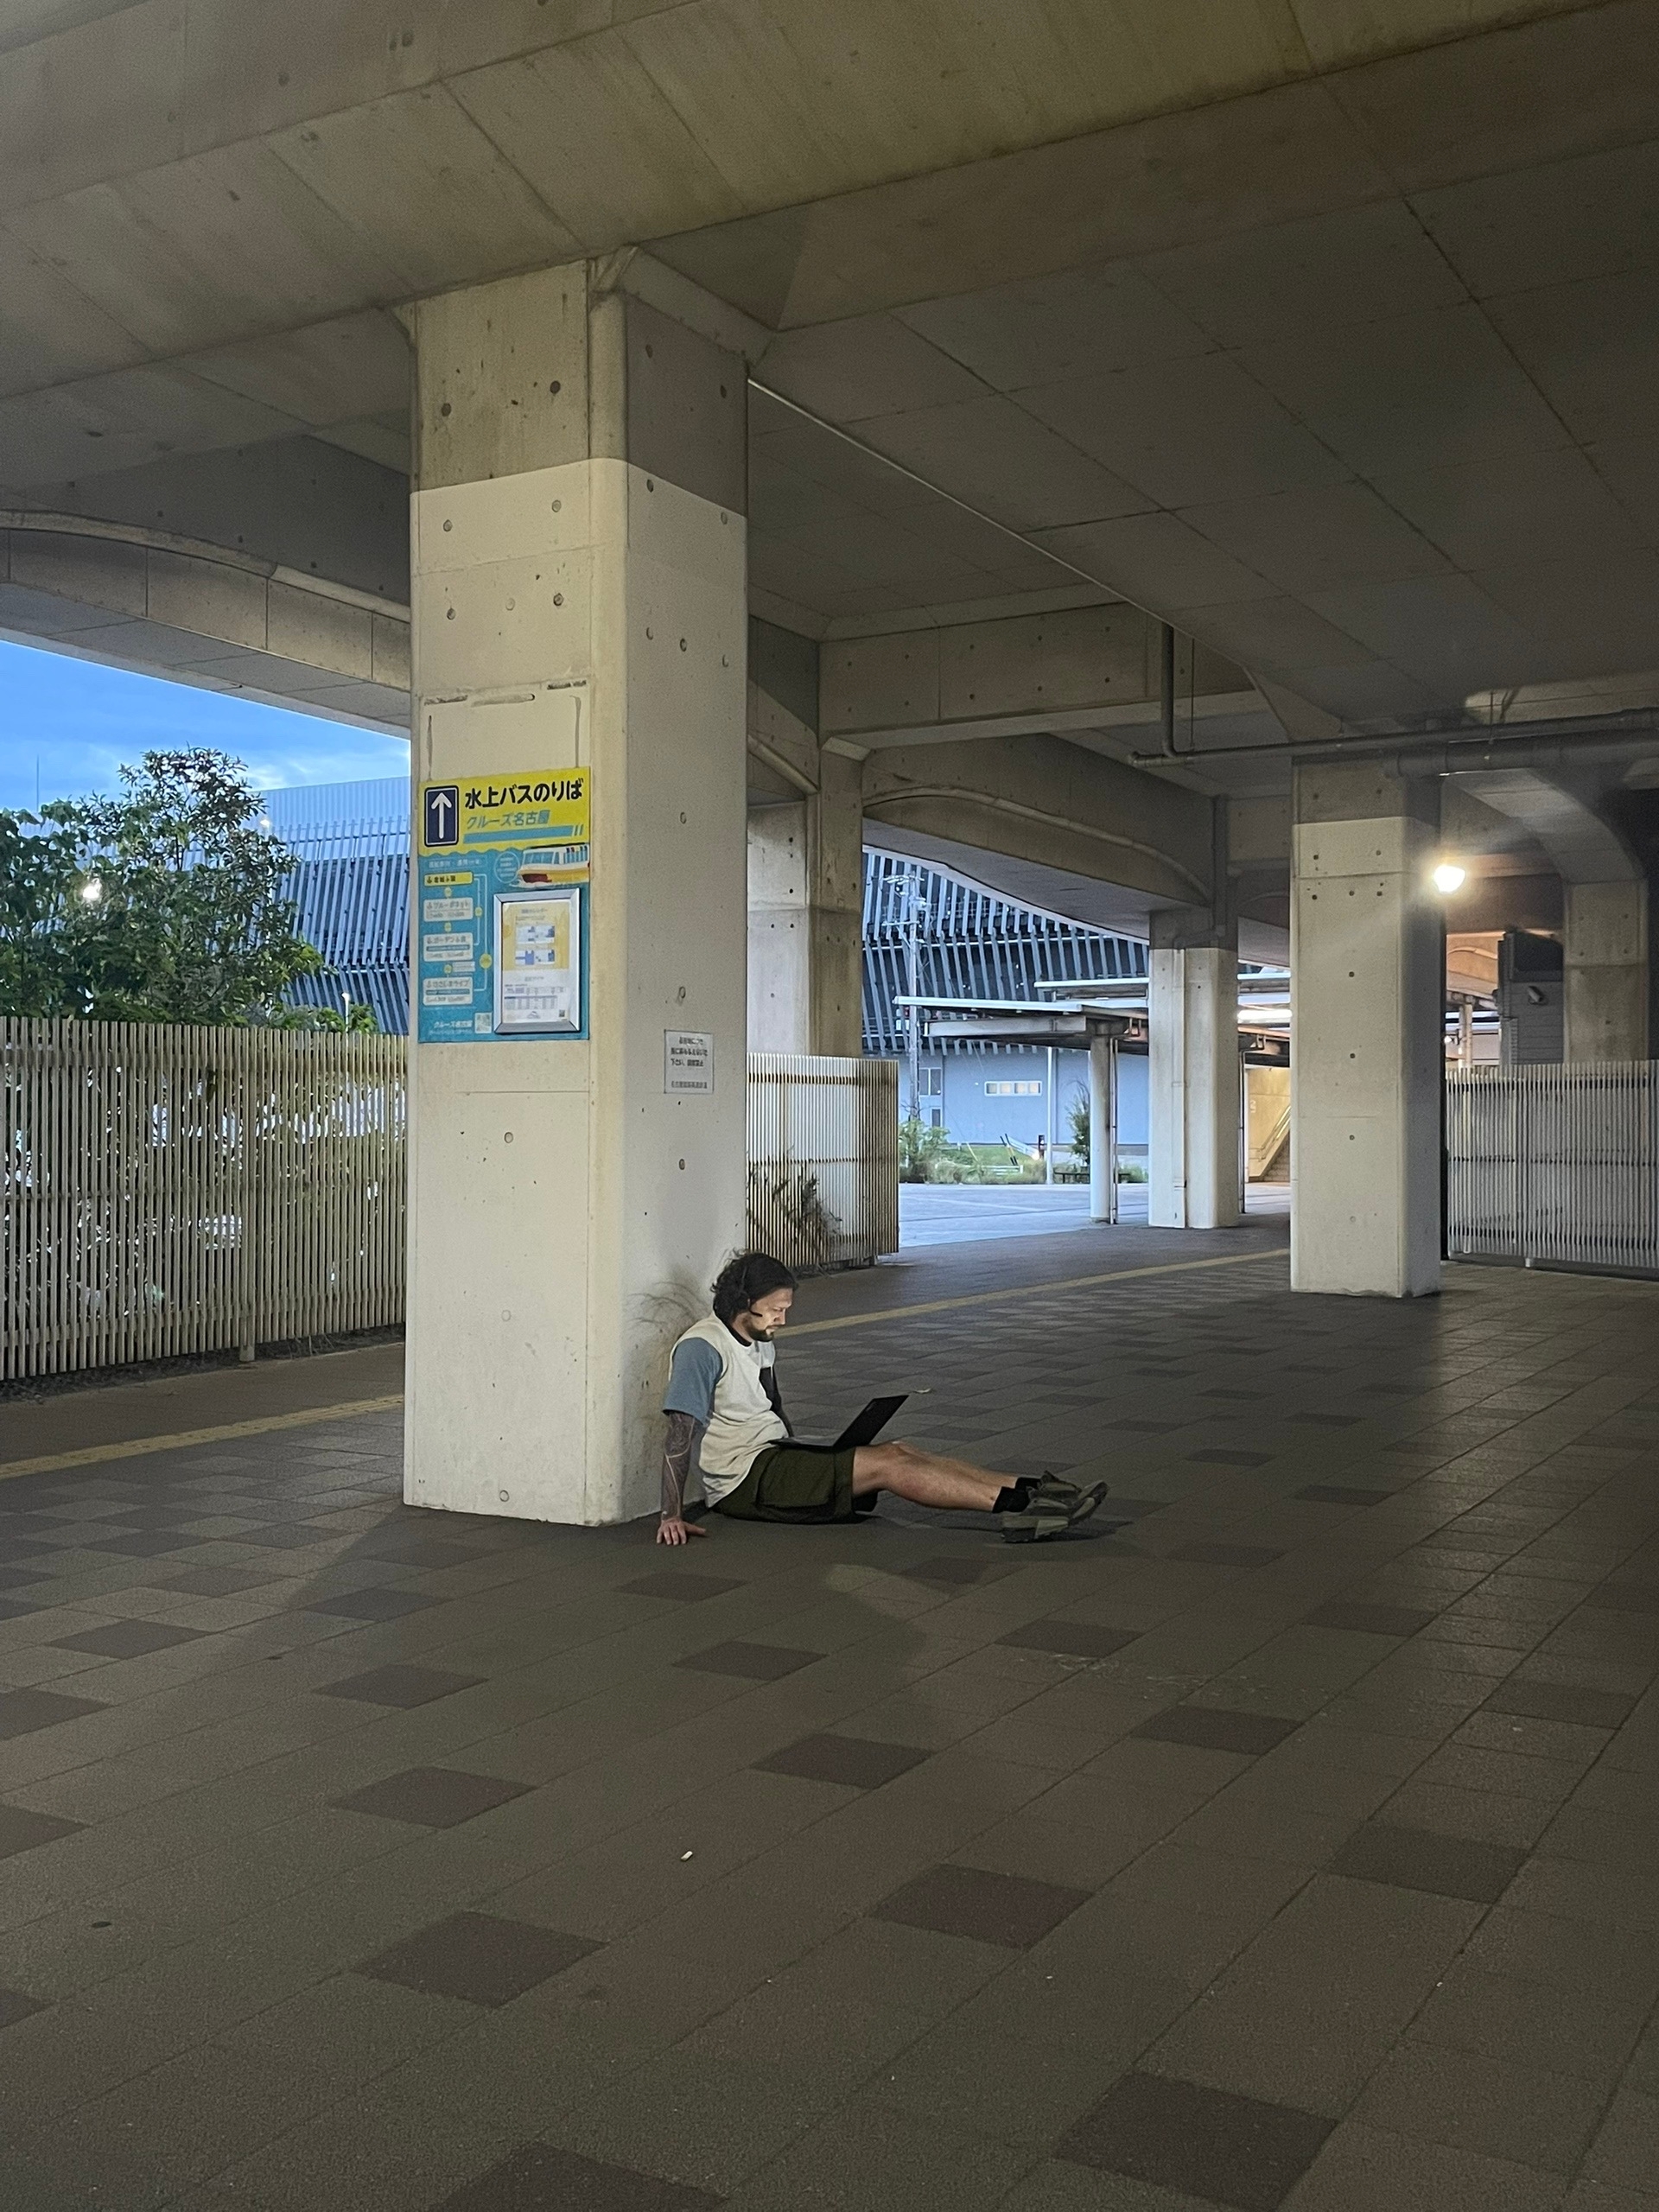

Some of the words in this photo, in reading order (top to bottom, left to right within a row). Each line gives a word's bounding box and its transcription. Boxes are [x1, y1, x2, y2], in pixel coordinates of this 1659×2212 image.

[465, 778, 584, 809] 水上バスのりば
